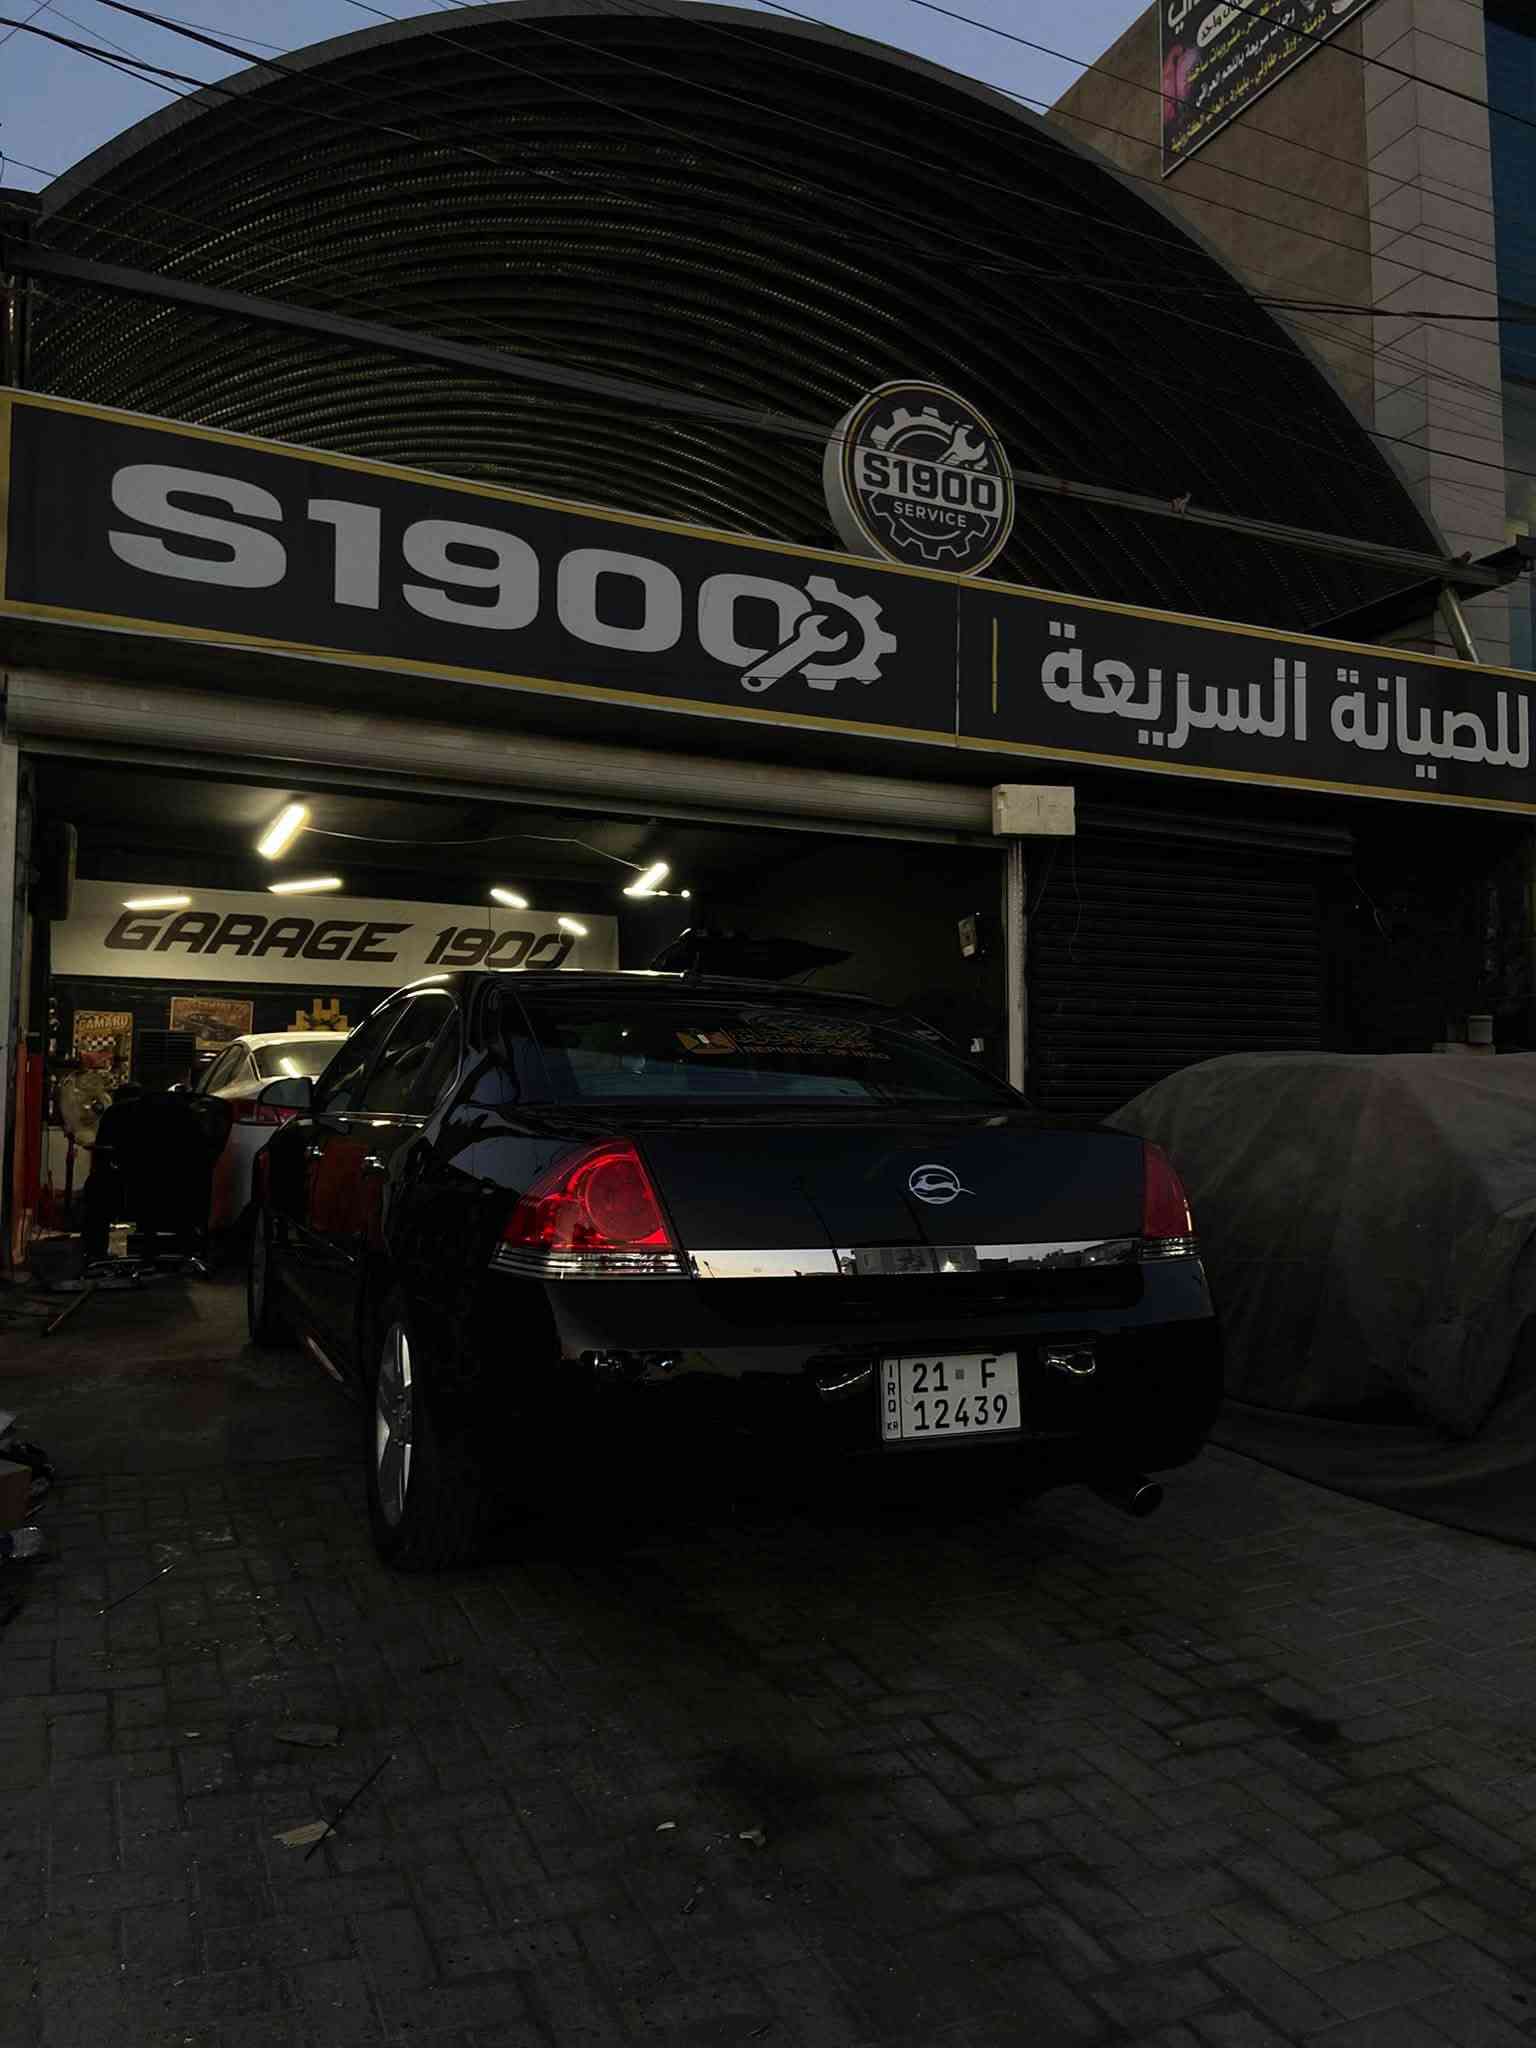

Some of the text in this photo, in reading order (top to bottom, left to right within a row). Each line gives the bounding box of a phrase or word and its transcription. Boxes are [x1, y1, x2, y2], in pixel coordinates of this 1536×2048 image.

[863, 452, 995, 512] S1900
[893, 500, 968, 529] SERVICE
[107, 462, 813, 669] S1900
[1040, 620, 1530, 781] للصيانة السريعة
[103, 910, 575, 969] GARAGE 1900
[912, 1357, 998, 1394] 21 F
[913, 1394, 1009, 1431] 12439
